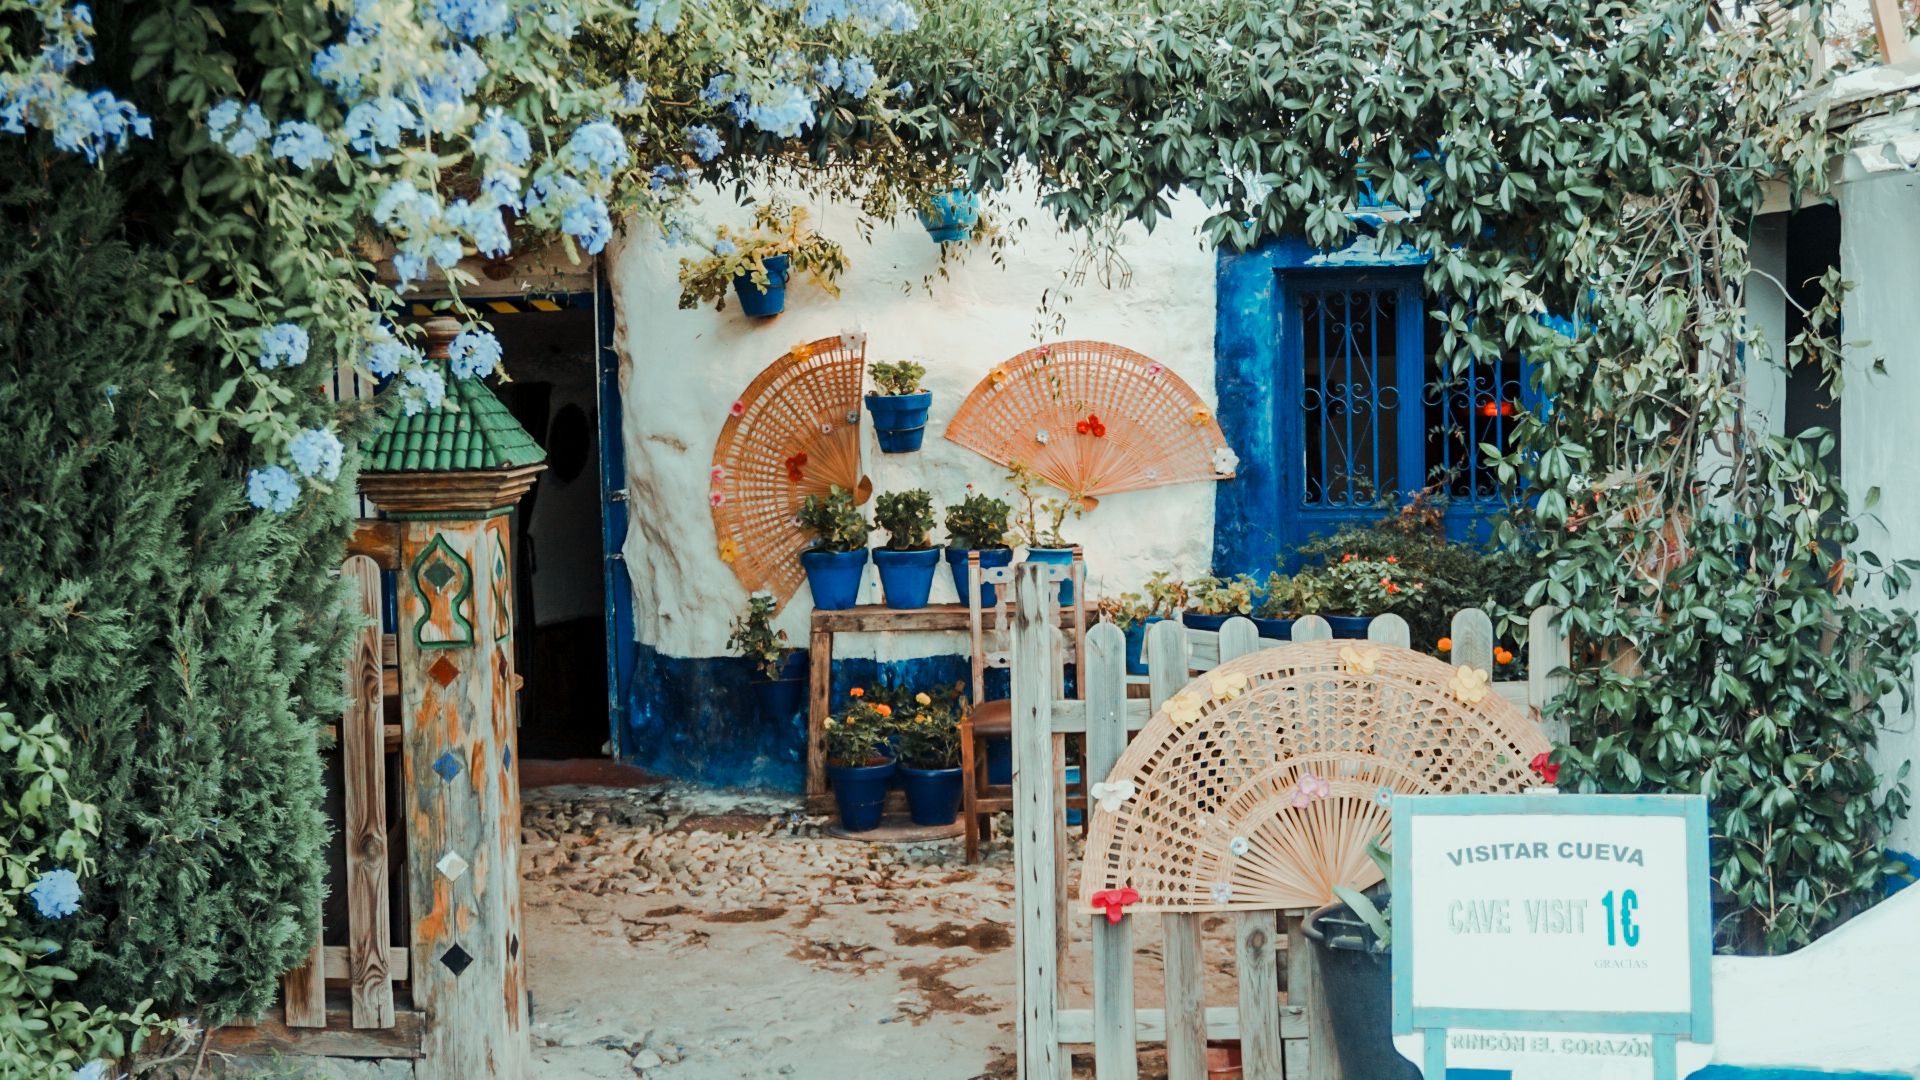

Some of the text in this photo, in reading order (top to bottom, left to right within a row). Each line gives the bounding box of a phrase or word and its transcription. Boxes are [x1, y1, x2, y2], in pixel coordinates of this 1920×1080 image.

[1447, 842, 1644, 867] VISITAR CUEVA
[1449, 889, 1640, 947] CAVE VISIT 1€
[1594, 959, 1649, 969] GRACIAS
[1452, 1032, 1525, 1053] RINCÓN
